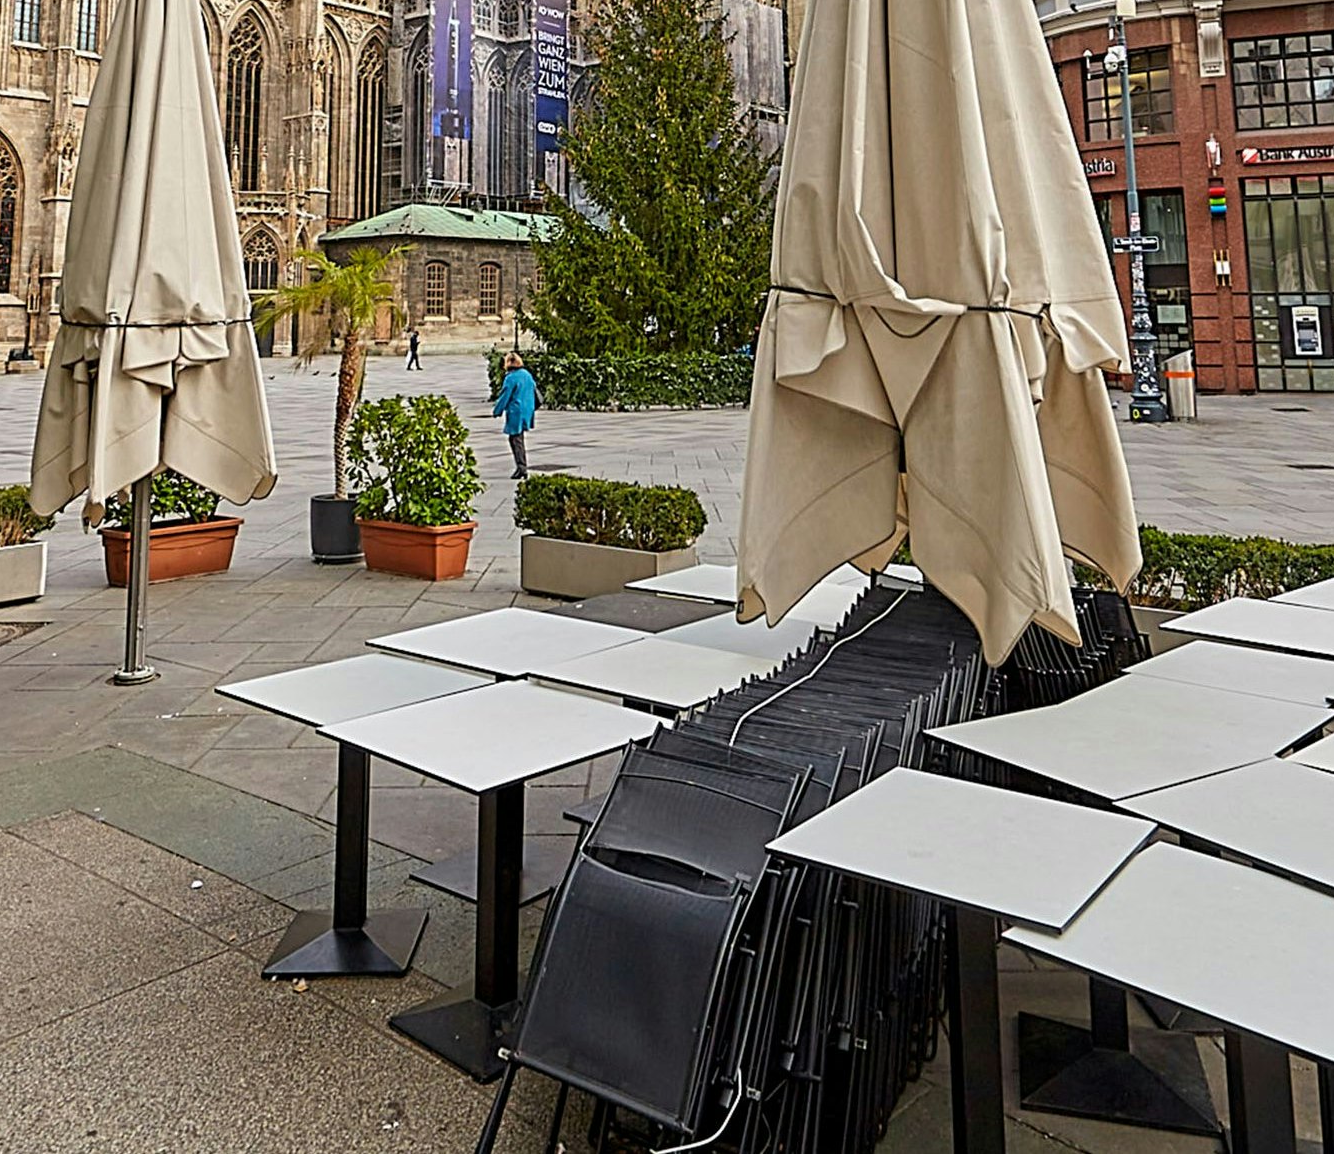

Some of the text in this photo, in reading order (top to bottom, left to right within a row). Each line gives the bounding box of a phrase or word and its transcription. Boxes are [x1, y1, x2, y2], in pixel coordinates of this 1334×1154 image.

[538, 30, 565, 46] BRINGT
[538, 43, 565, 59] GANZ
[538, 56, 566, 73] WIEN
[538, 70, 566, 90] ZUM
[1259, 148, 1295, 161] Bank
